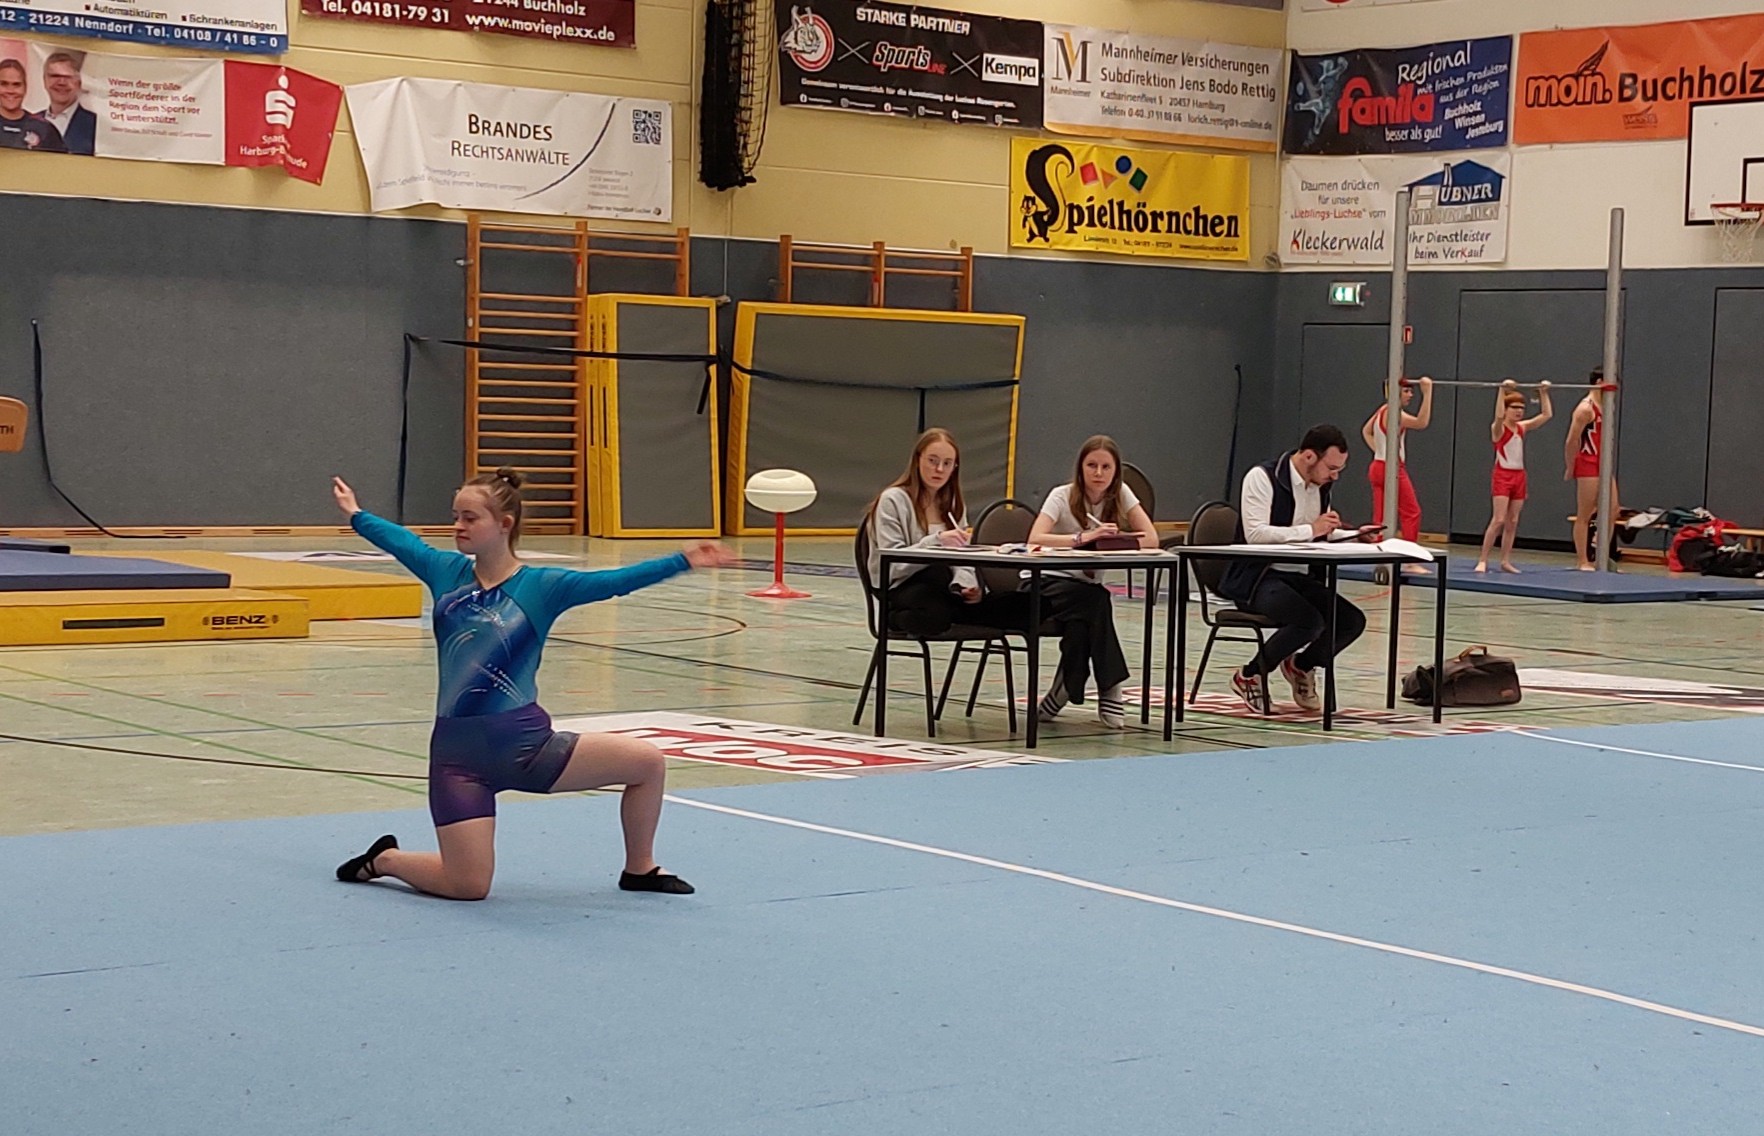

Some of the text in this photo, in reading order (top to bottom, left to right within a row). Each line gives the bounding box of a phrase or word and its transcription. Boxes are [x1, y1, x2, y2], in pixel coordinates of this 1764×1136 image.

[322, 0, 347, 14] Tel.
[523, 0, 586, 16] Buchholz
[29, 13, 70, 26] 21224
[75, 17, 133, 32] Nenndorf
[145, 25, 169, 38] Tel.
[224, 33, 238, 44] 41
[465, 14, 615, 40] www.movieplexx.de
[856, 7, 971, 36] STARKE PARTNER
[984, 56, 1037, 81] Kempa
[1101, 42, 1270, 77] Mannheimer Versicherungen
[1398, 41, 1472, 86] Regional
[1100, 67, 1277, 102] Subdirektion Jens Bodo Rettig
[1471, 79, 1500, 96] Region
[1337, 76, 1436, 135] famila
[1443, 99, 1482, 121] Buchholz
[468, 113, 554, 142] BRANDES
[1384, 124, 1443, 143] besser als gut!
[450, 140, 571, 167] RECHTSANWÄLTE
[1025, 144, 1240, 242] Spielhörnchen
[1301, 178, 1380, 192] Daumen drücken
[1318, 194, 1360, 206] für unsere
[1368, 209, 1387, 219] vom
[1290, 228, 1386, 251] Kleckerwald
[1408, 229, 1492, 244] Ihr Dienstleister
[1414, 244, 1438, 259] beim
[211, 614, 266, 626] BENZ
